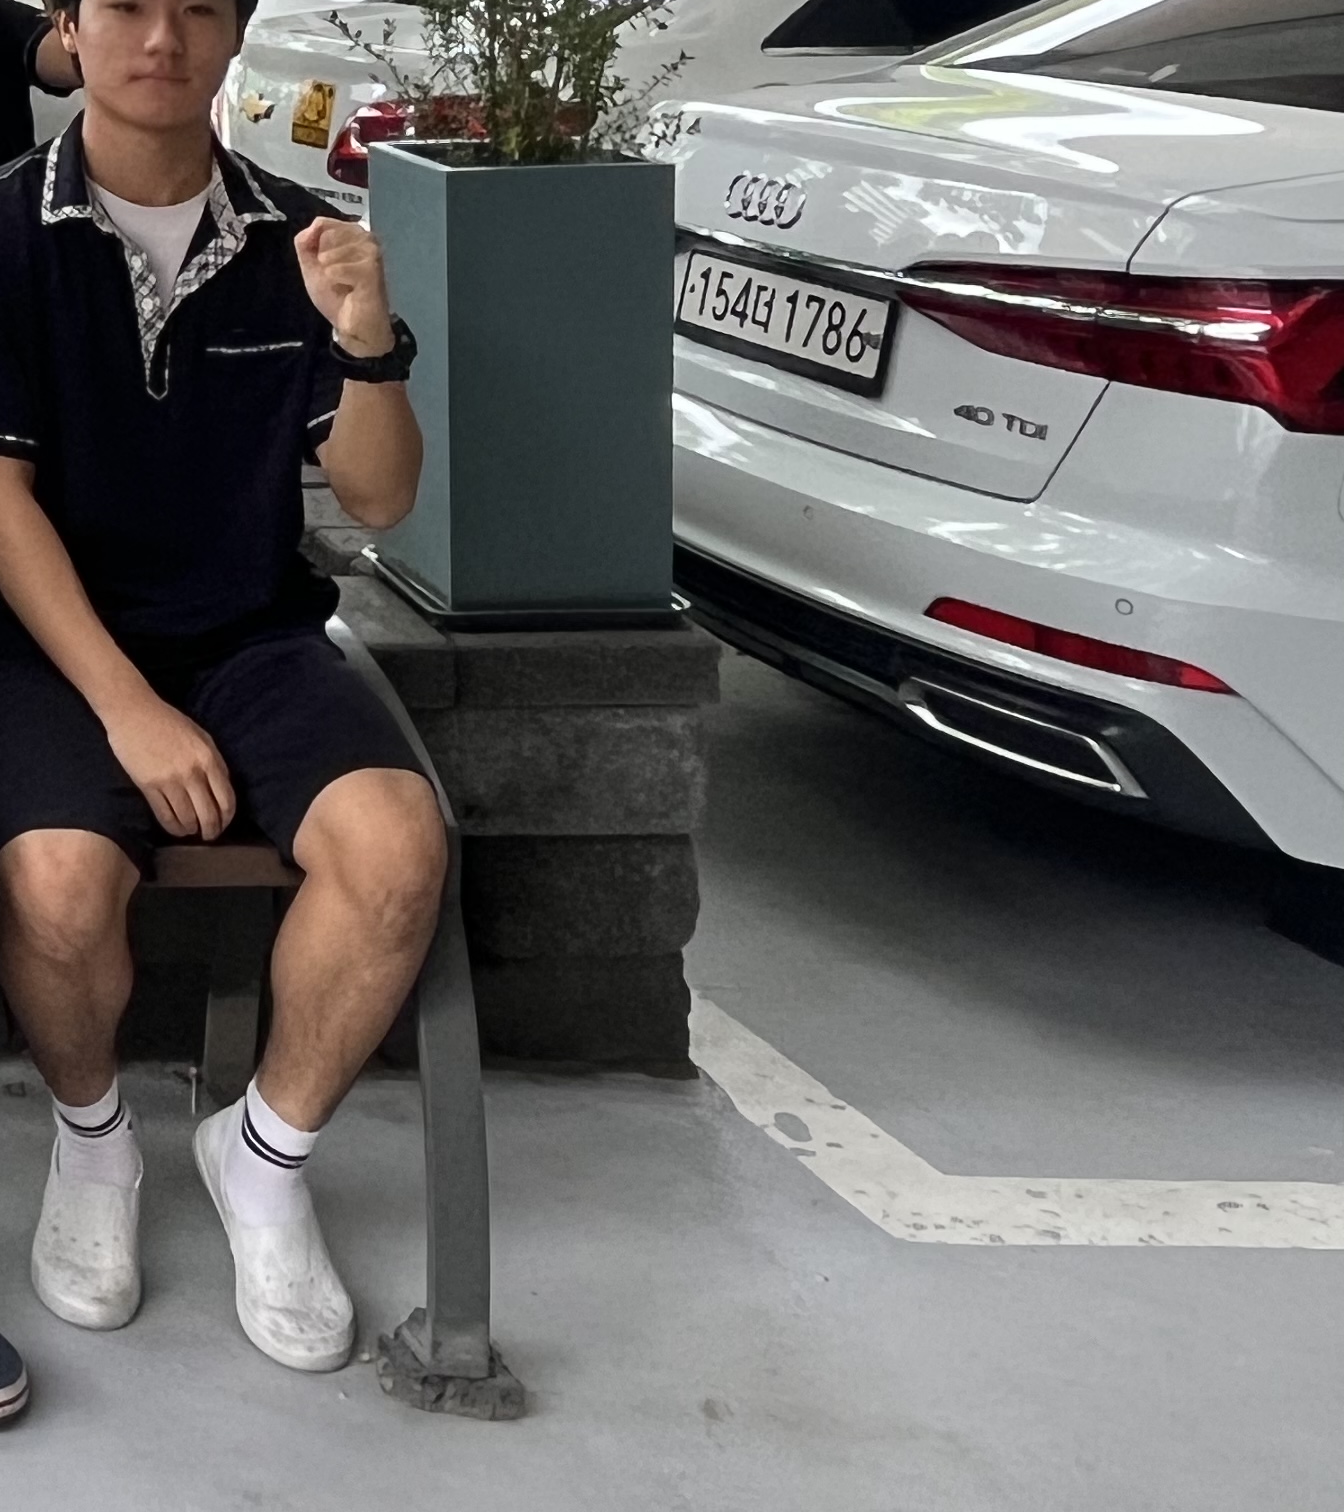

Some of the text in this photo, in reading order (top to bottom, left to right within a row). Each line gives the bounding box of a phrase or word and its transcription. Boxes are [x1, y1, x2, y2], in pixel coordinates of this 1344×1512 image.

[786, 289, 868, 363] 1786
[953, 404, 1048, 440] 40 TDI
